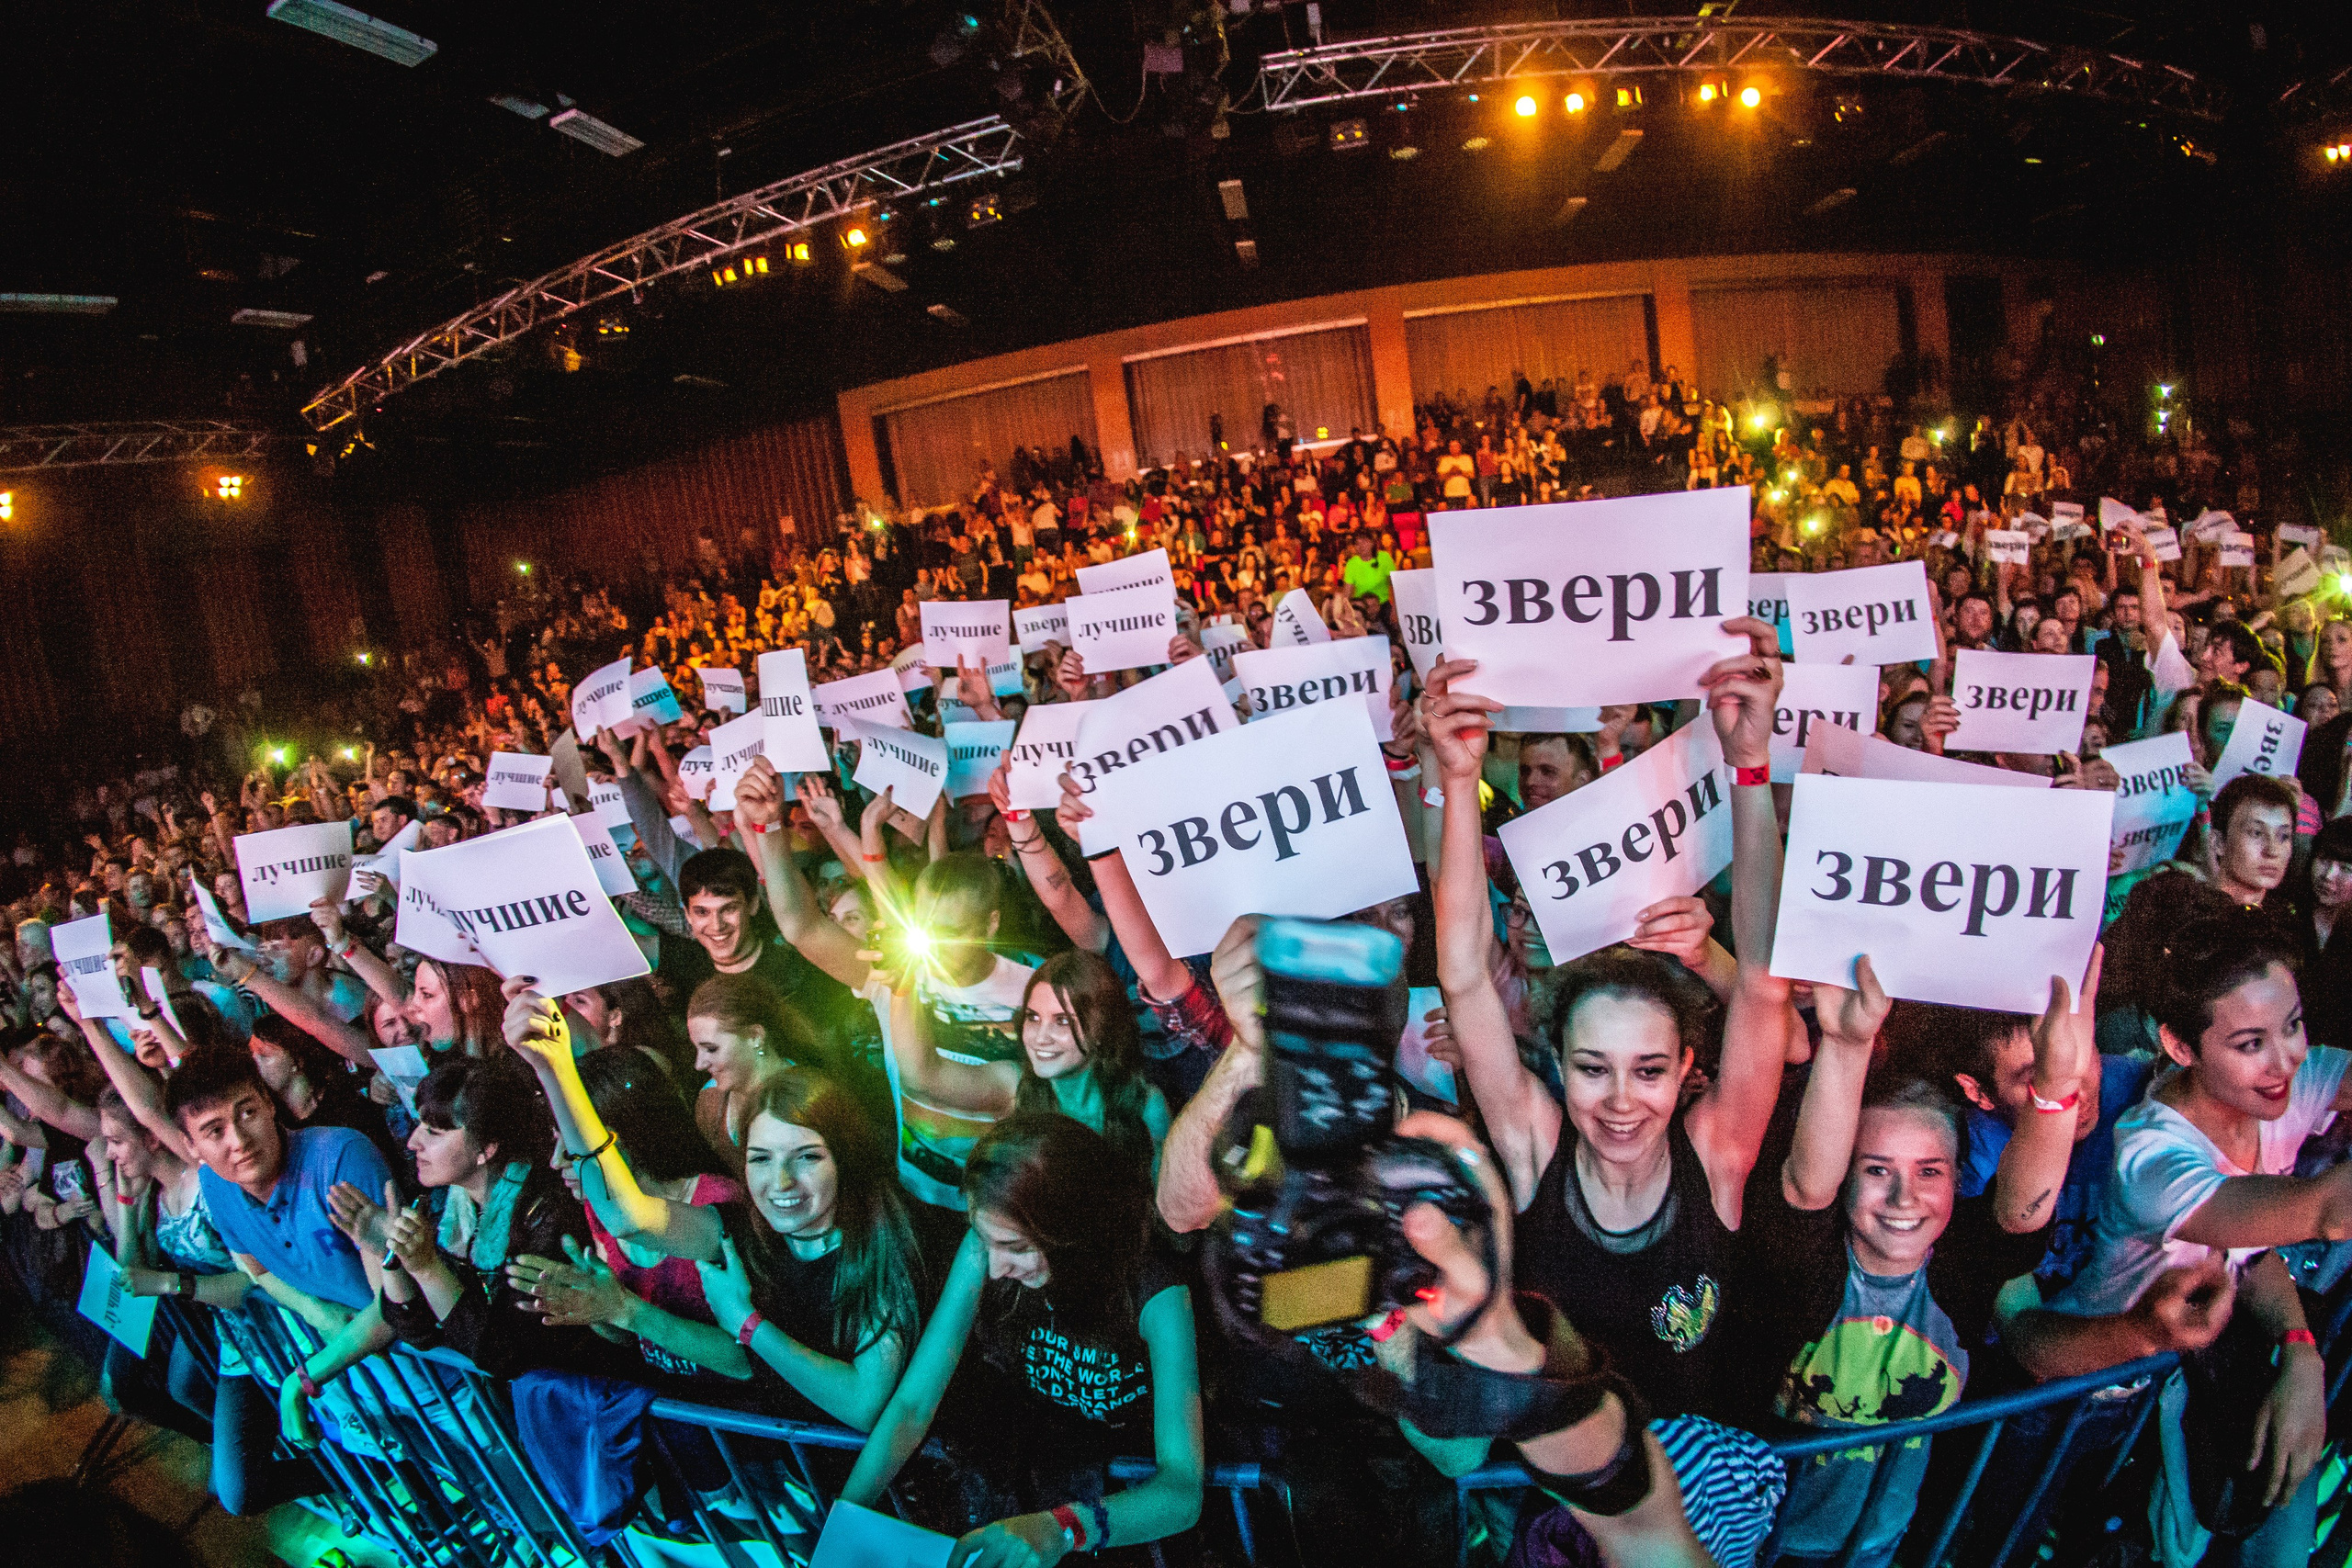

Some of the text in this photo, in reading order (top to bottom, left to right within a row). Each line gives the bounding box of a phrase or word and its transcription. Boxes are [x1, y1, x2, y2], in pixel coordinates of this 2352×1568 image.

[1462, 567, 1724, 642] звери
[1802, 598, 1918, 637] звери
[929, 622, 1002, 642] лучшие
[1078, 612, 1167, 641] лучшие
[831, 690, 897, 716] лучшие
[1250, 668, 1380, 713] звери
[1965, 682, 2079, 722] звери
[1772, 706, 1862, 748] ери
[680, 759, 715, 777] луч
[866, 735, 940, 778] лучшие
[1012, 739, 1076, 767] луч
[491, 770, 544, 785] лучшие
[1136, 765, 1372, 877] звери
[1541, 768, 1724, 900] звери
[252, 852, 348, 885] лучшие
[1810, 849, 2080, 937] звери
[1043, 1347, 1074, 1377] THE
[1080, 1385, 1120, 1401] LET
